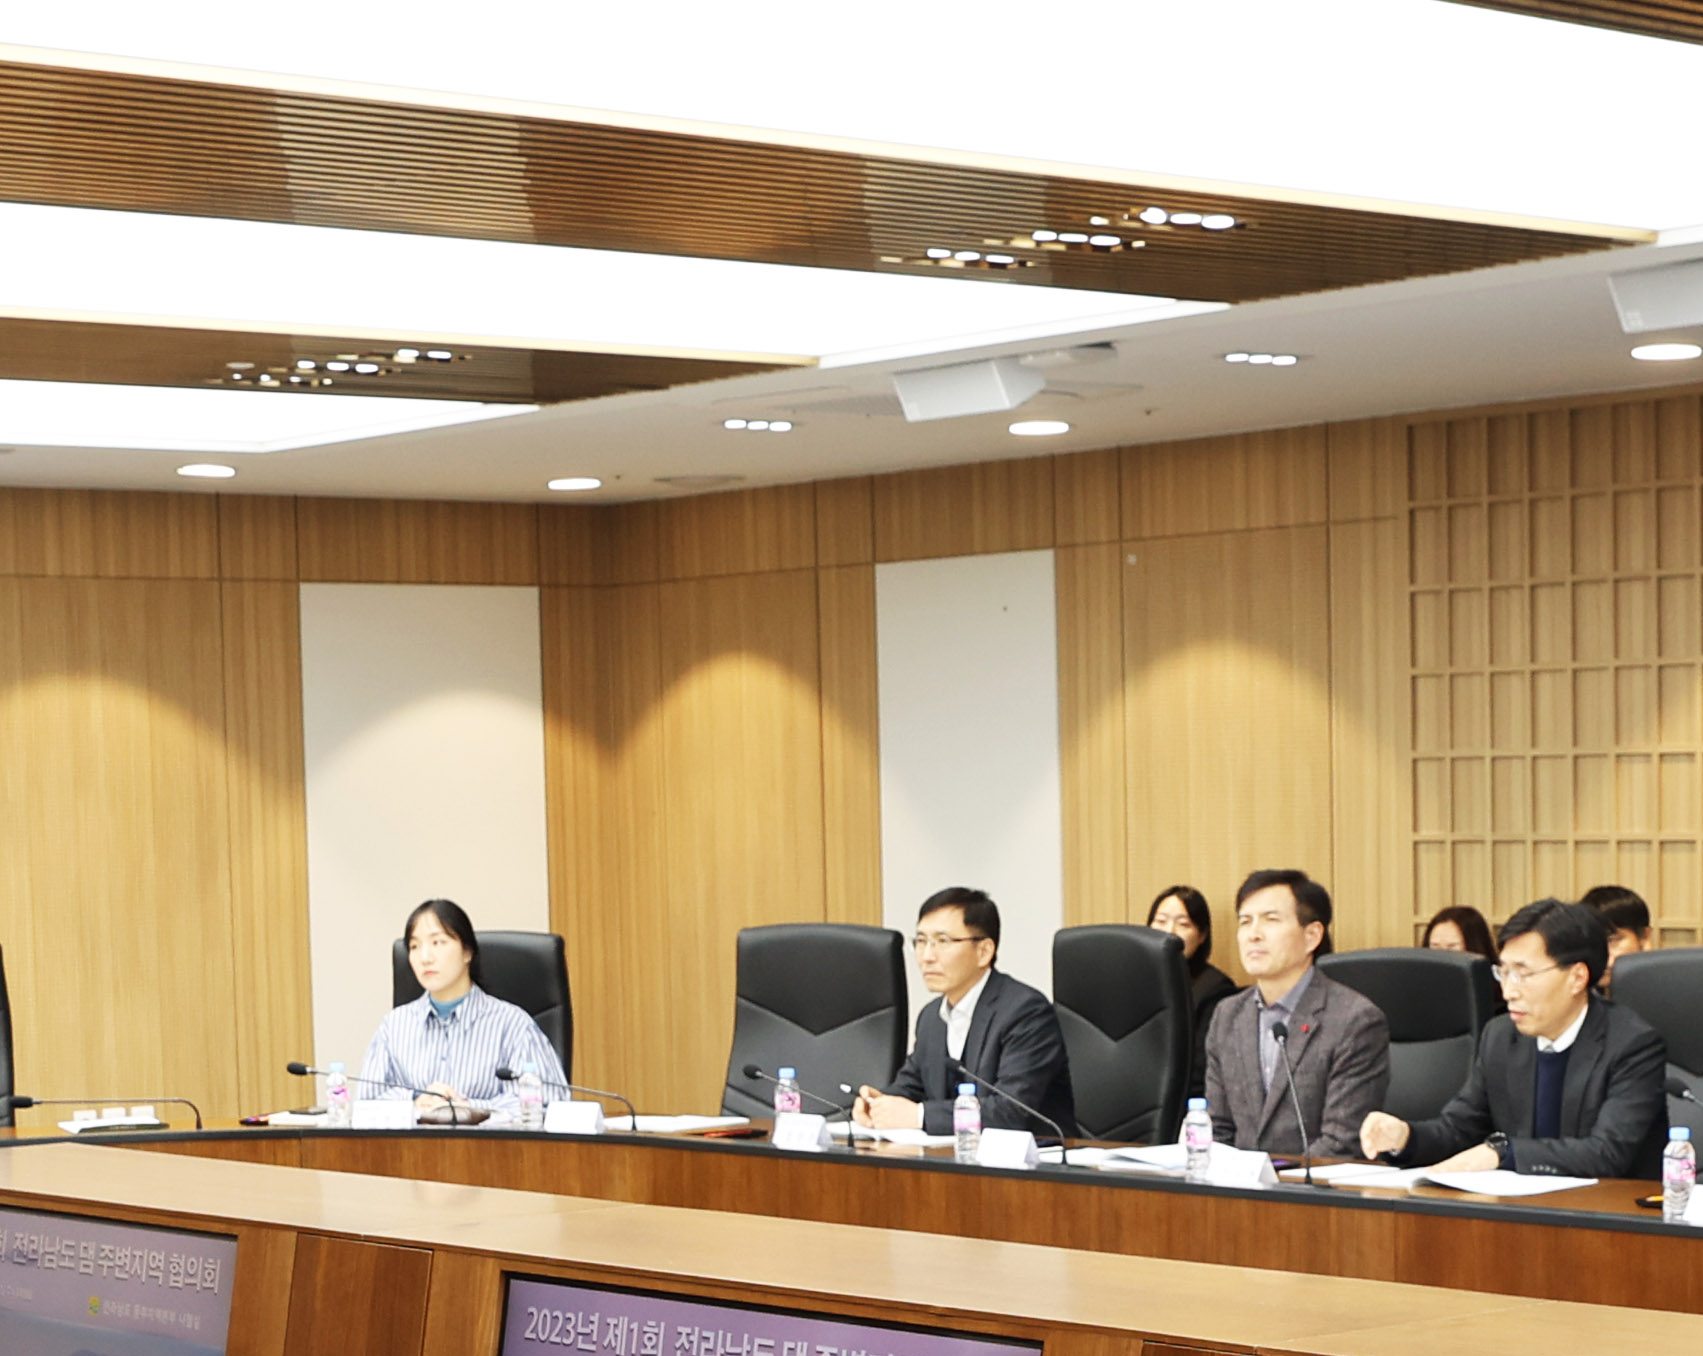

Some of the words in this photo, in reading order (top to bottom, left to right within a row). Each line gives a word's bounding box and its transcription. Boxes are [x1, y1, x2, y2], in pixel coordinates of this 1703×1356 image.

[12, 1232, 77, 1271] 전라남도
[79, 1240, 95, 1276] 댐
[97, 1243, 164, 1288] 주변지역
[168, 1252, 222, 1295] 협의회
[523, 1306, 600, 1351] 2023년
